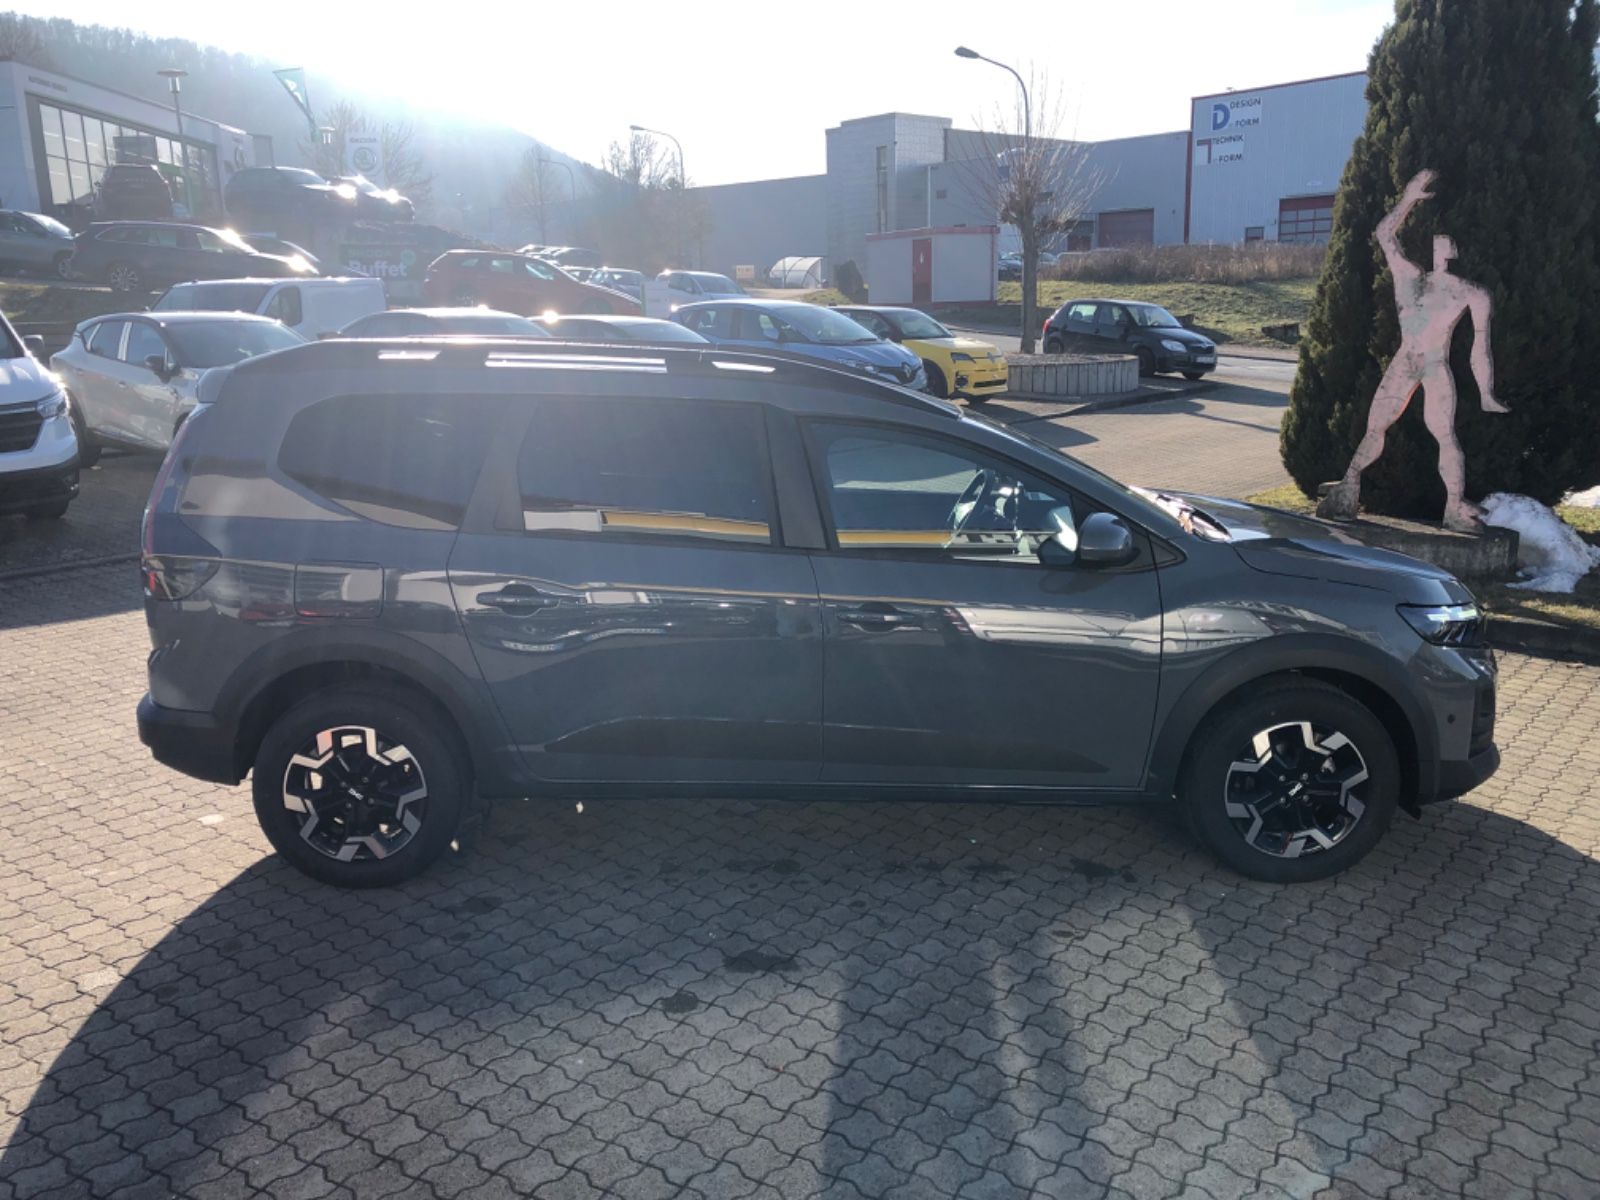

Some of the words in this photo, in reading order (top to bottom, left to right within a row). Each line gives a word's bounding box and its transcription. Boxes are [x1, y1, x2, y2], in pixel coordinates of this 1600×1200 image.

[1229, 98, 1261, 109] DESIGN
[1213, 103, 1230, 130] D
[1235, 118, 1259, 127] FORM
[1219, 153, 1242, 162] FORM
